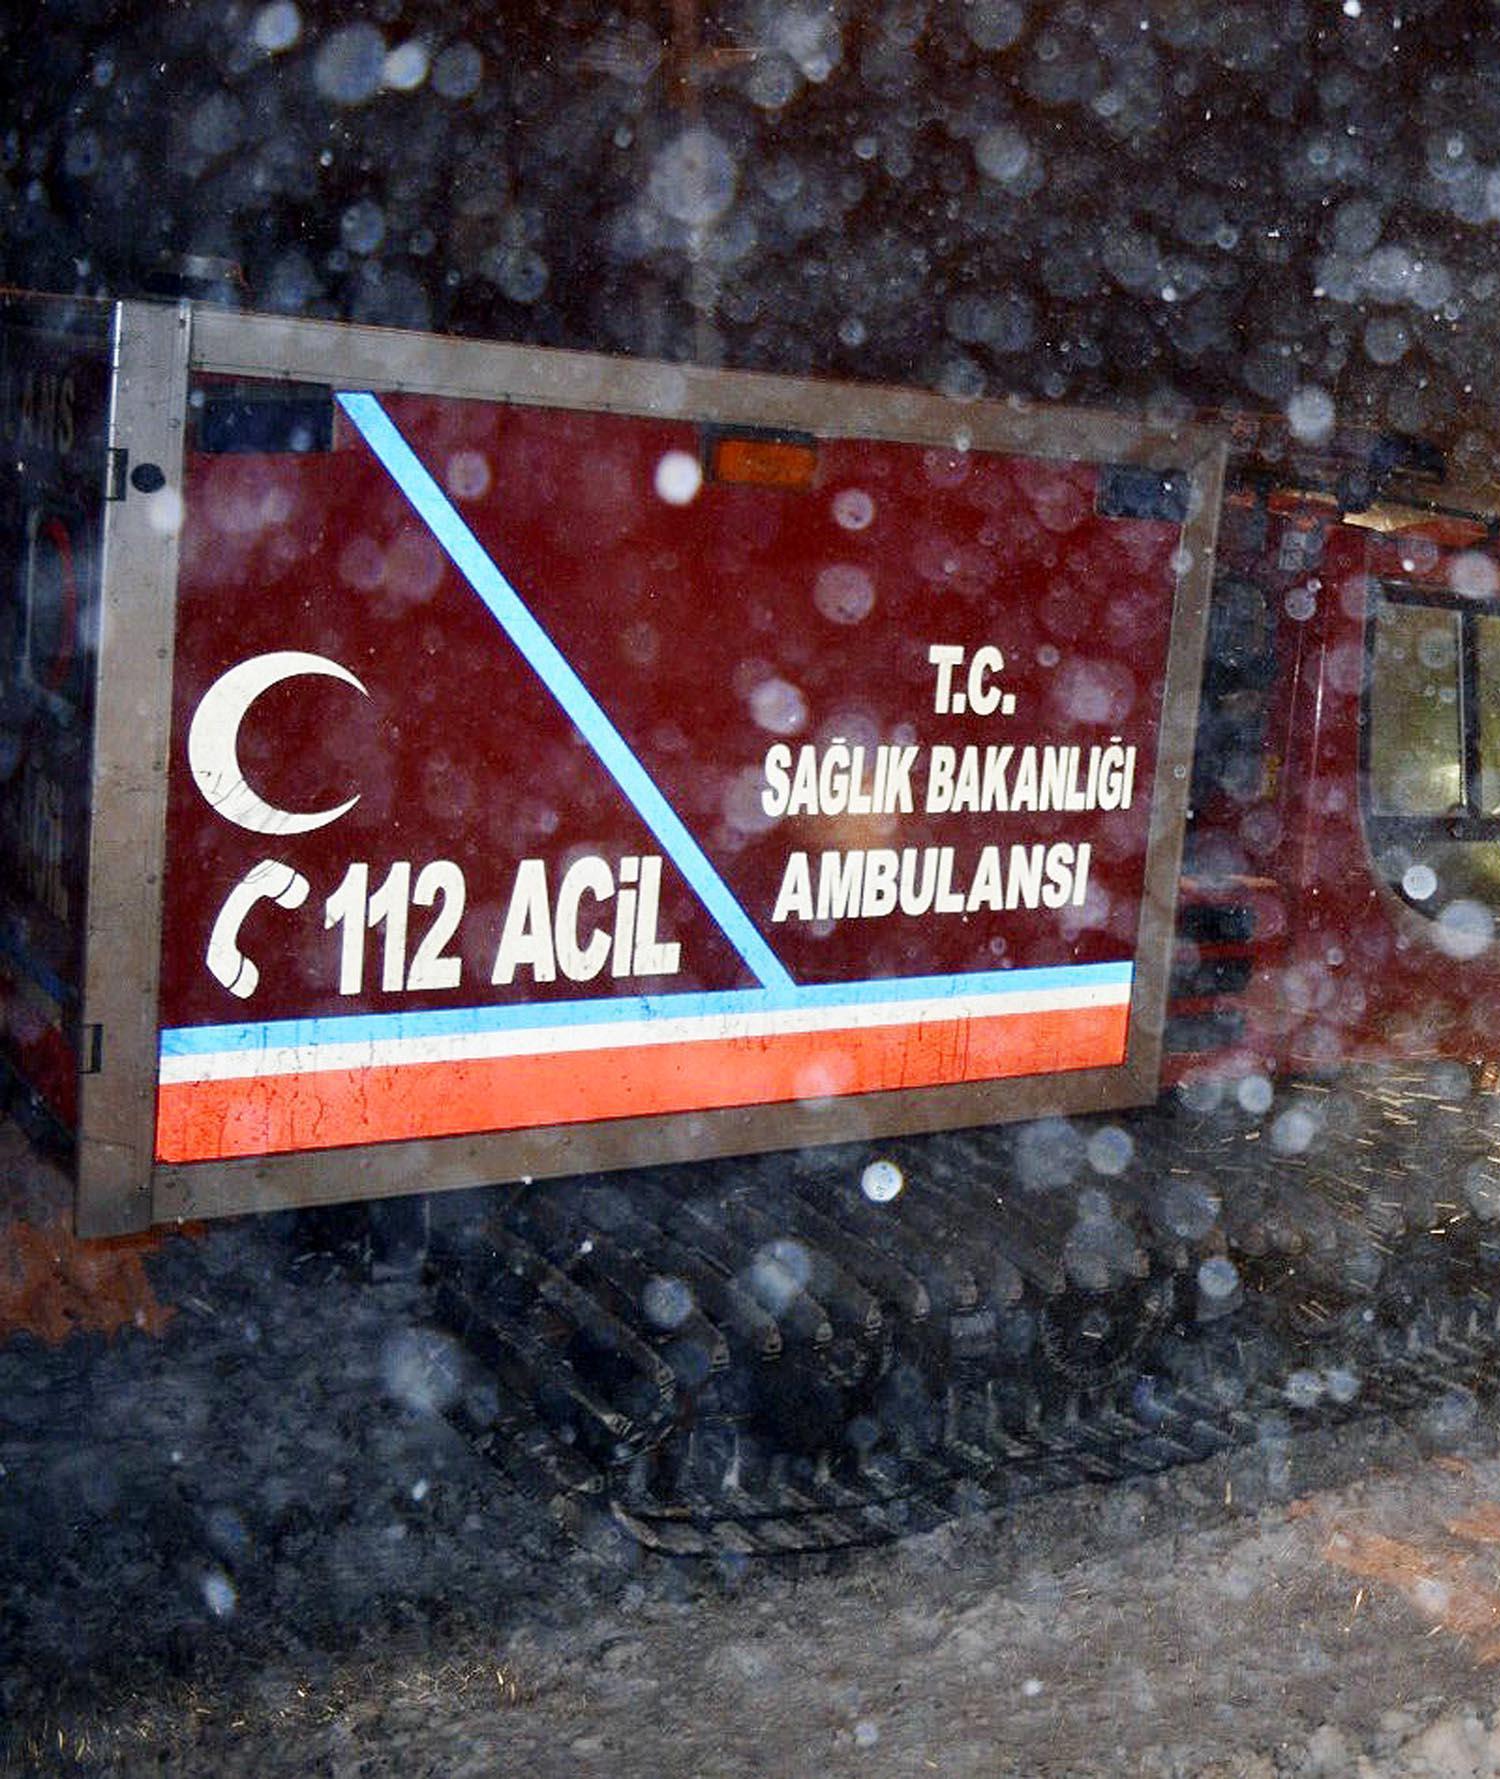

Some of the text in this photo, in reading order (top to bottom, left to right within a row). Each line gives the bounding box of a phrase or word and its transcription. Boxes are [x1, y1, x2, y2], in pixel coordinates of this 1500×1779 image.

[928, 645, 1016, 716] T.C.
[761, 735, 1137, 818] SAĞLIK BAKANLIĞI
[771, 842, 1092, 923] AMBULANSI
[324, 860, 467, 996] 112
